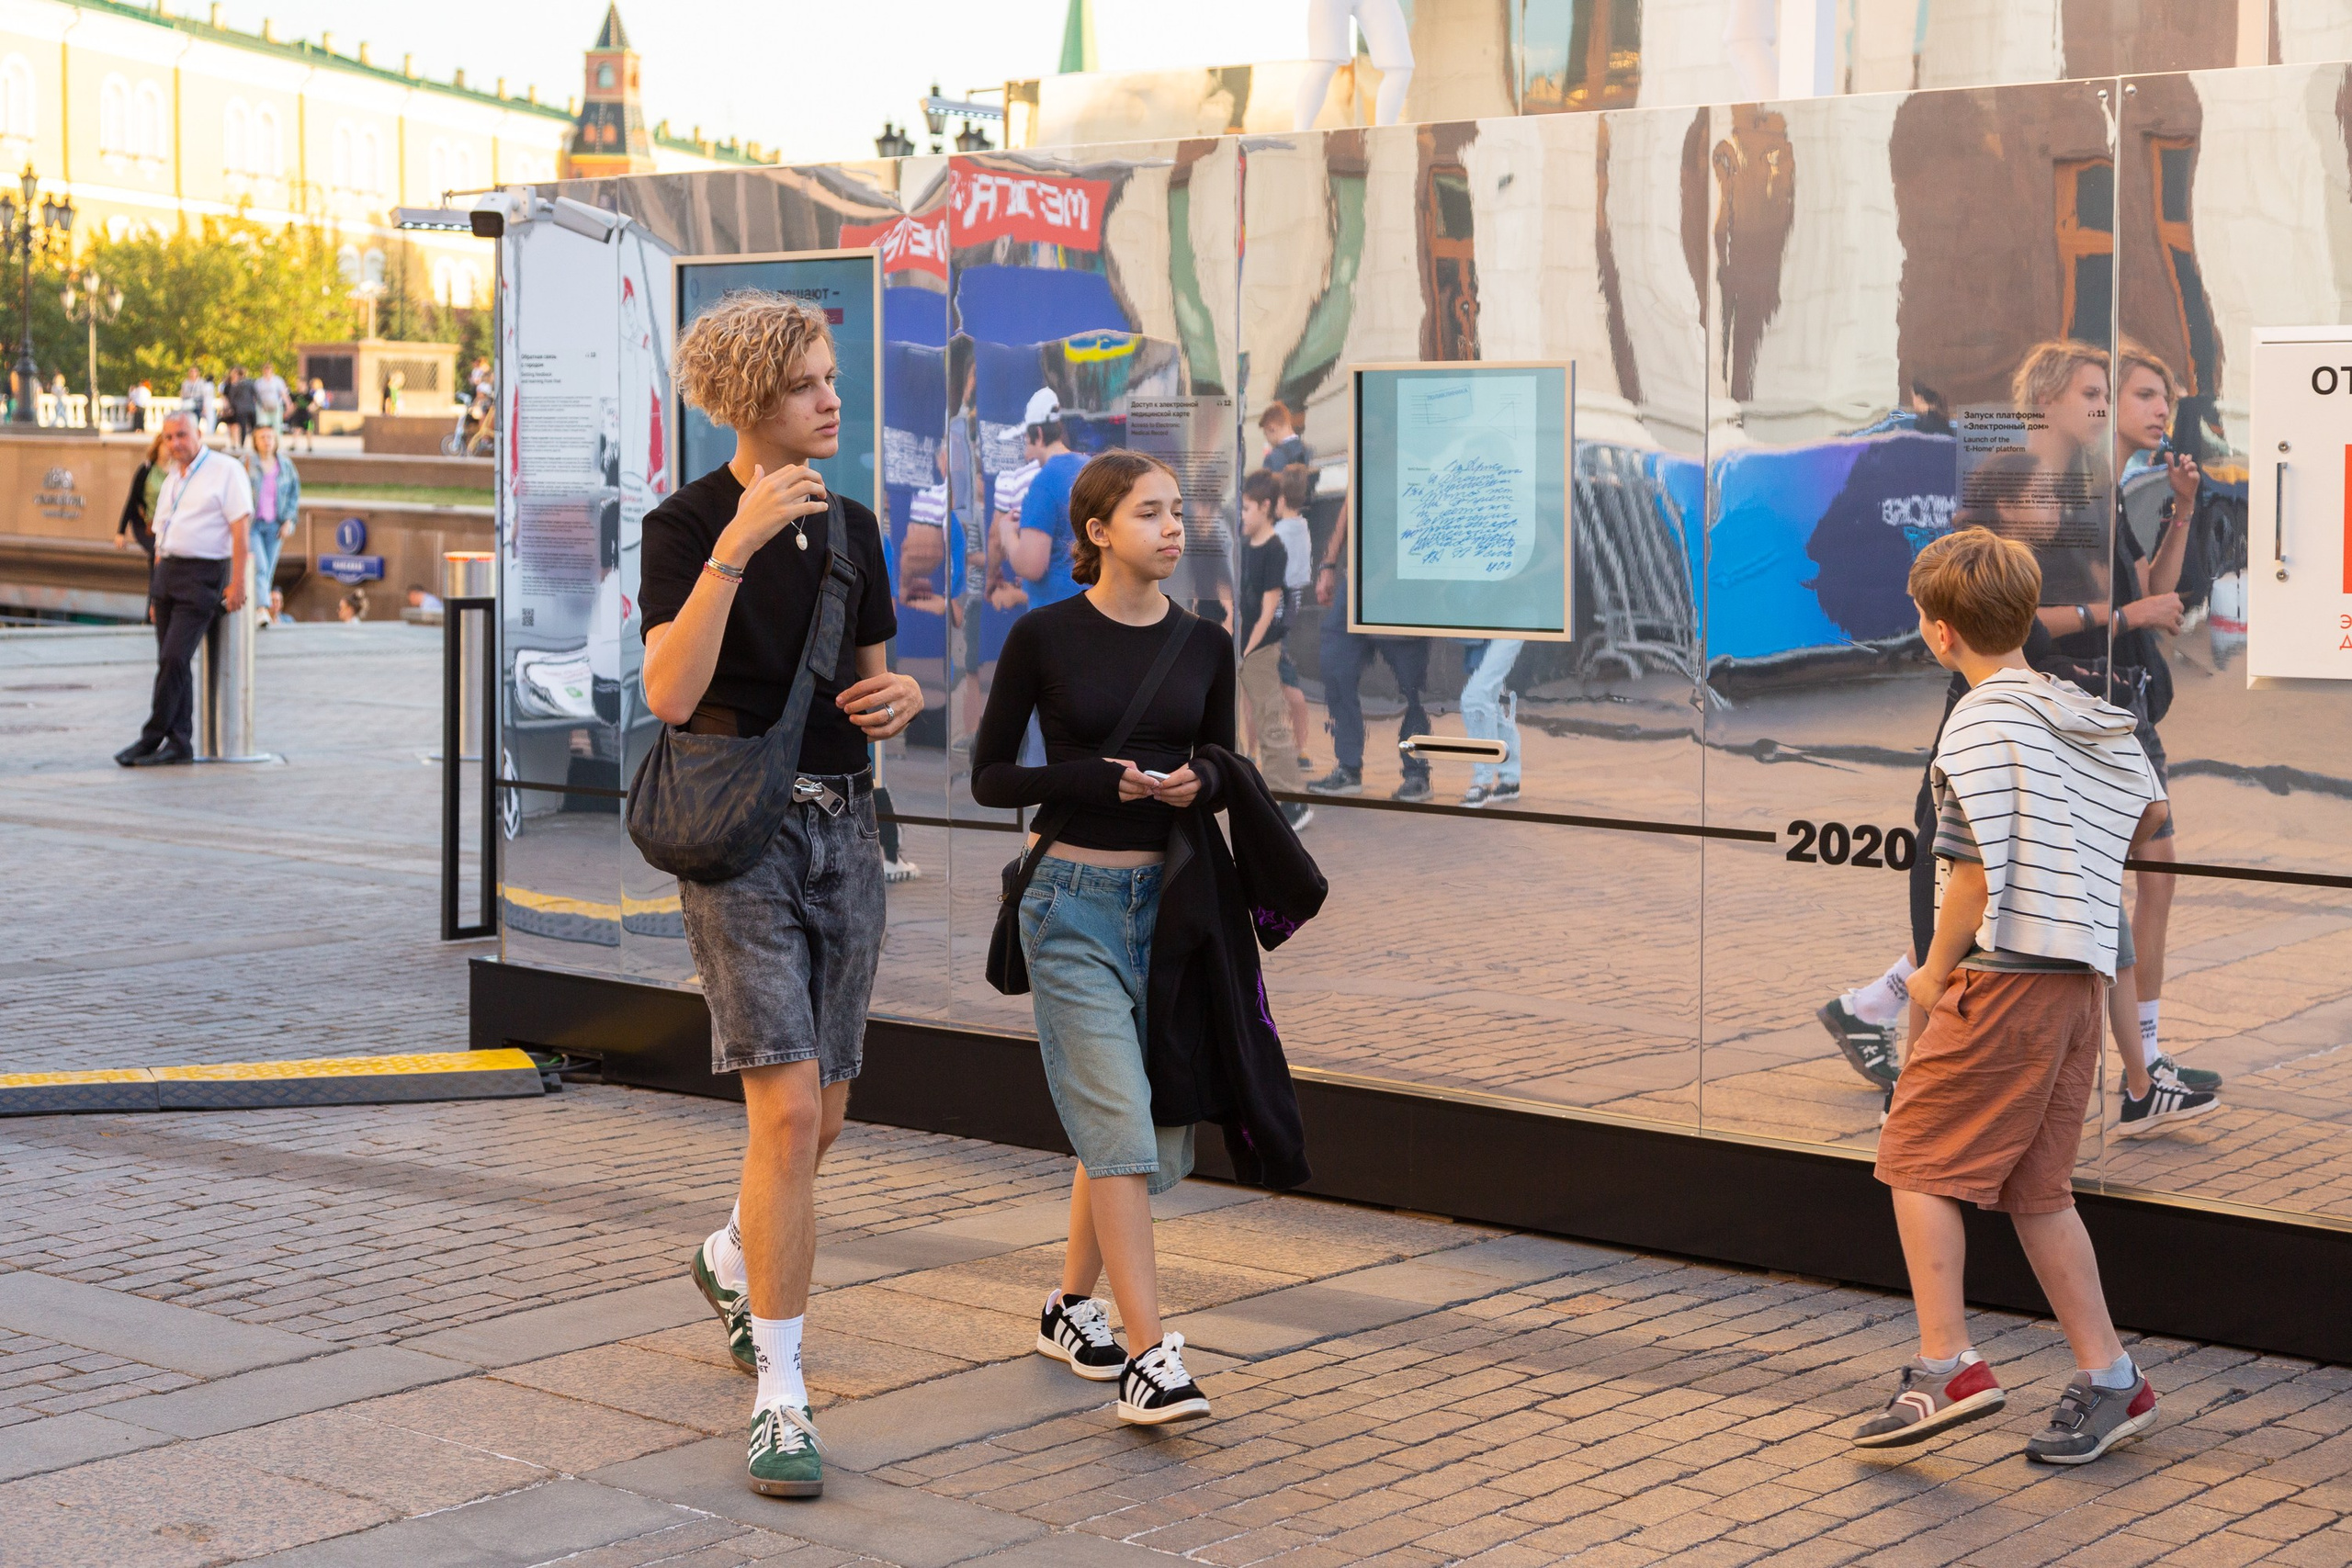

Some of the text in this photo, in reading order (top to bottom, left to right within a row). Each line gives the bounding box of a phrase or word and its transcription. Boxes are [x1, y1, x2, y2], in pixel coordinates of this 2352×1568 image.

[1131, 400, 1153, 409] Доступ
[1159, 400, 1199, 409] электронной
[1964, 411, 2045, 420] Запуск платформы
[1963, 422, 2026, 431] «Электронный
[1786, 819, 1917, 871] 2020
